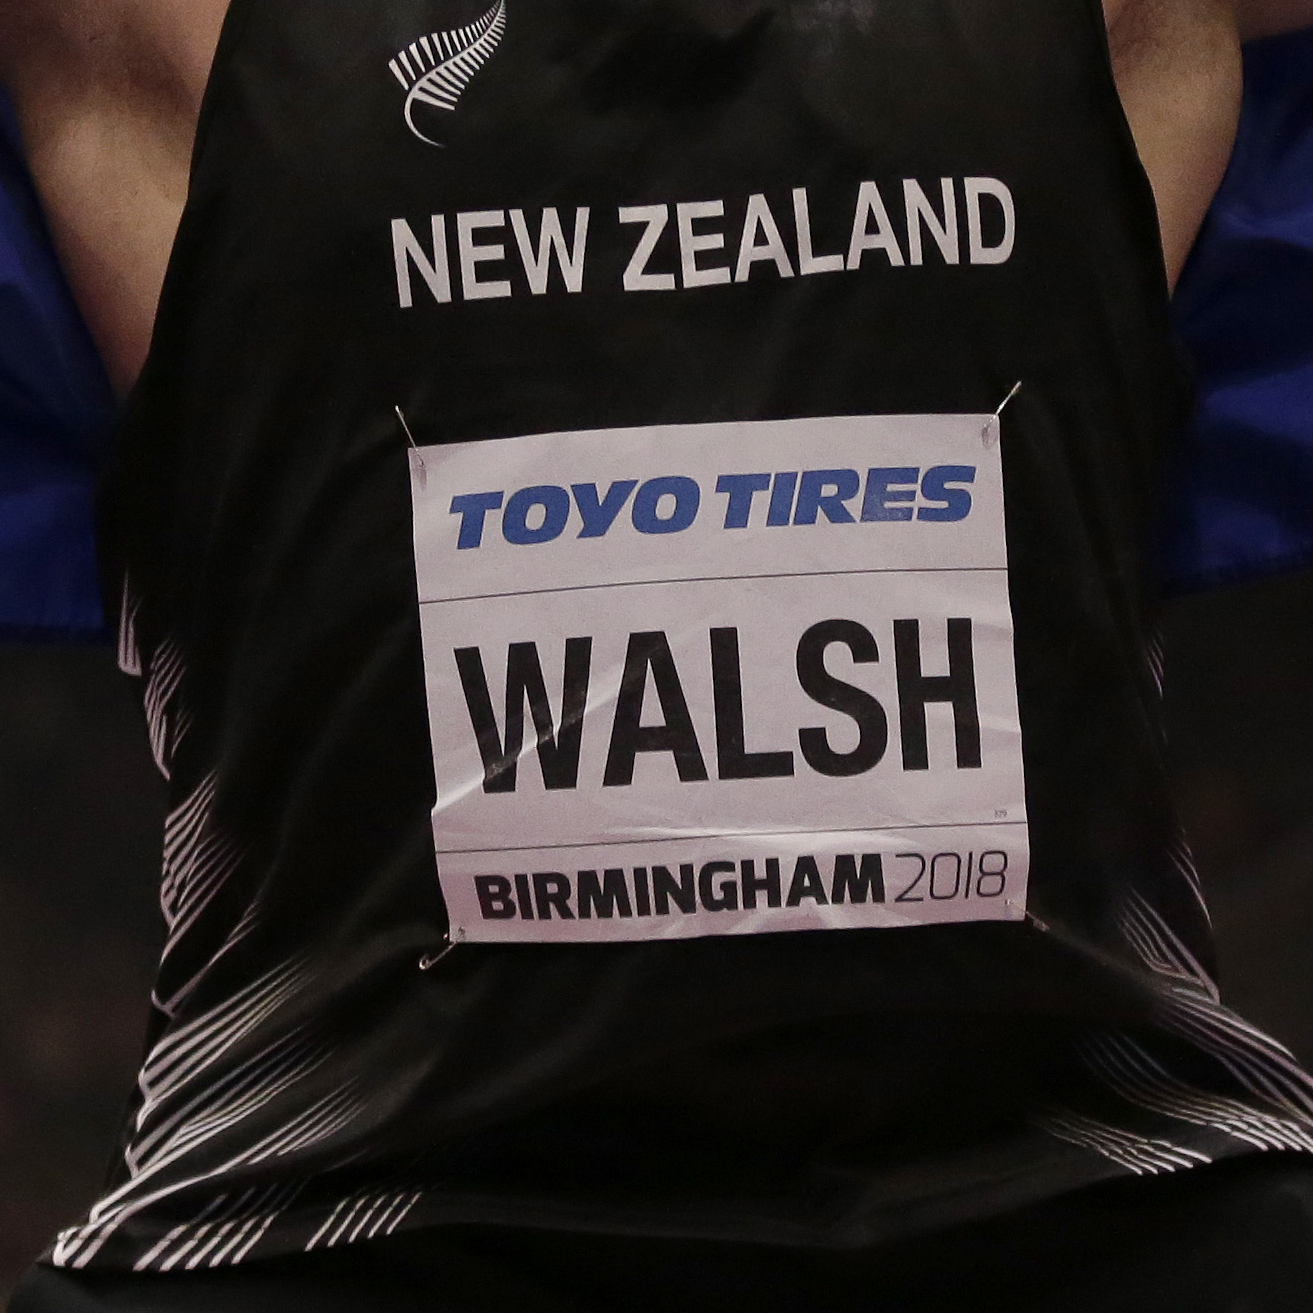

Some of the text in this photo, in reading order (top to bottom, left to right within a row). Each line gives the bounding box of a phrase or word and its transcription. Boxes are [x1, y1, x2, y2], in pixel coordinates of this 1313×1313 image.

[390, 176, 1016, 309] NEW ZEALAND
[449, 464, 977, 550] TOYO TIRES
[453, 617, 982, 794] WALSH
[473, 849, 1009, 922] BIRMINGHAM 2018
